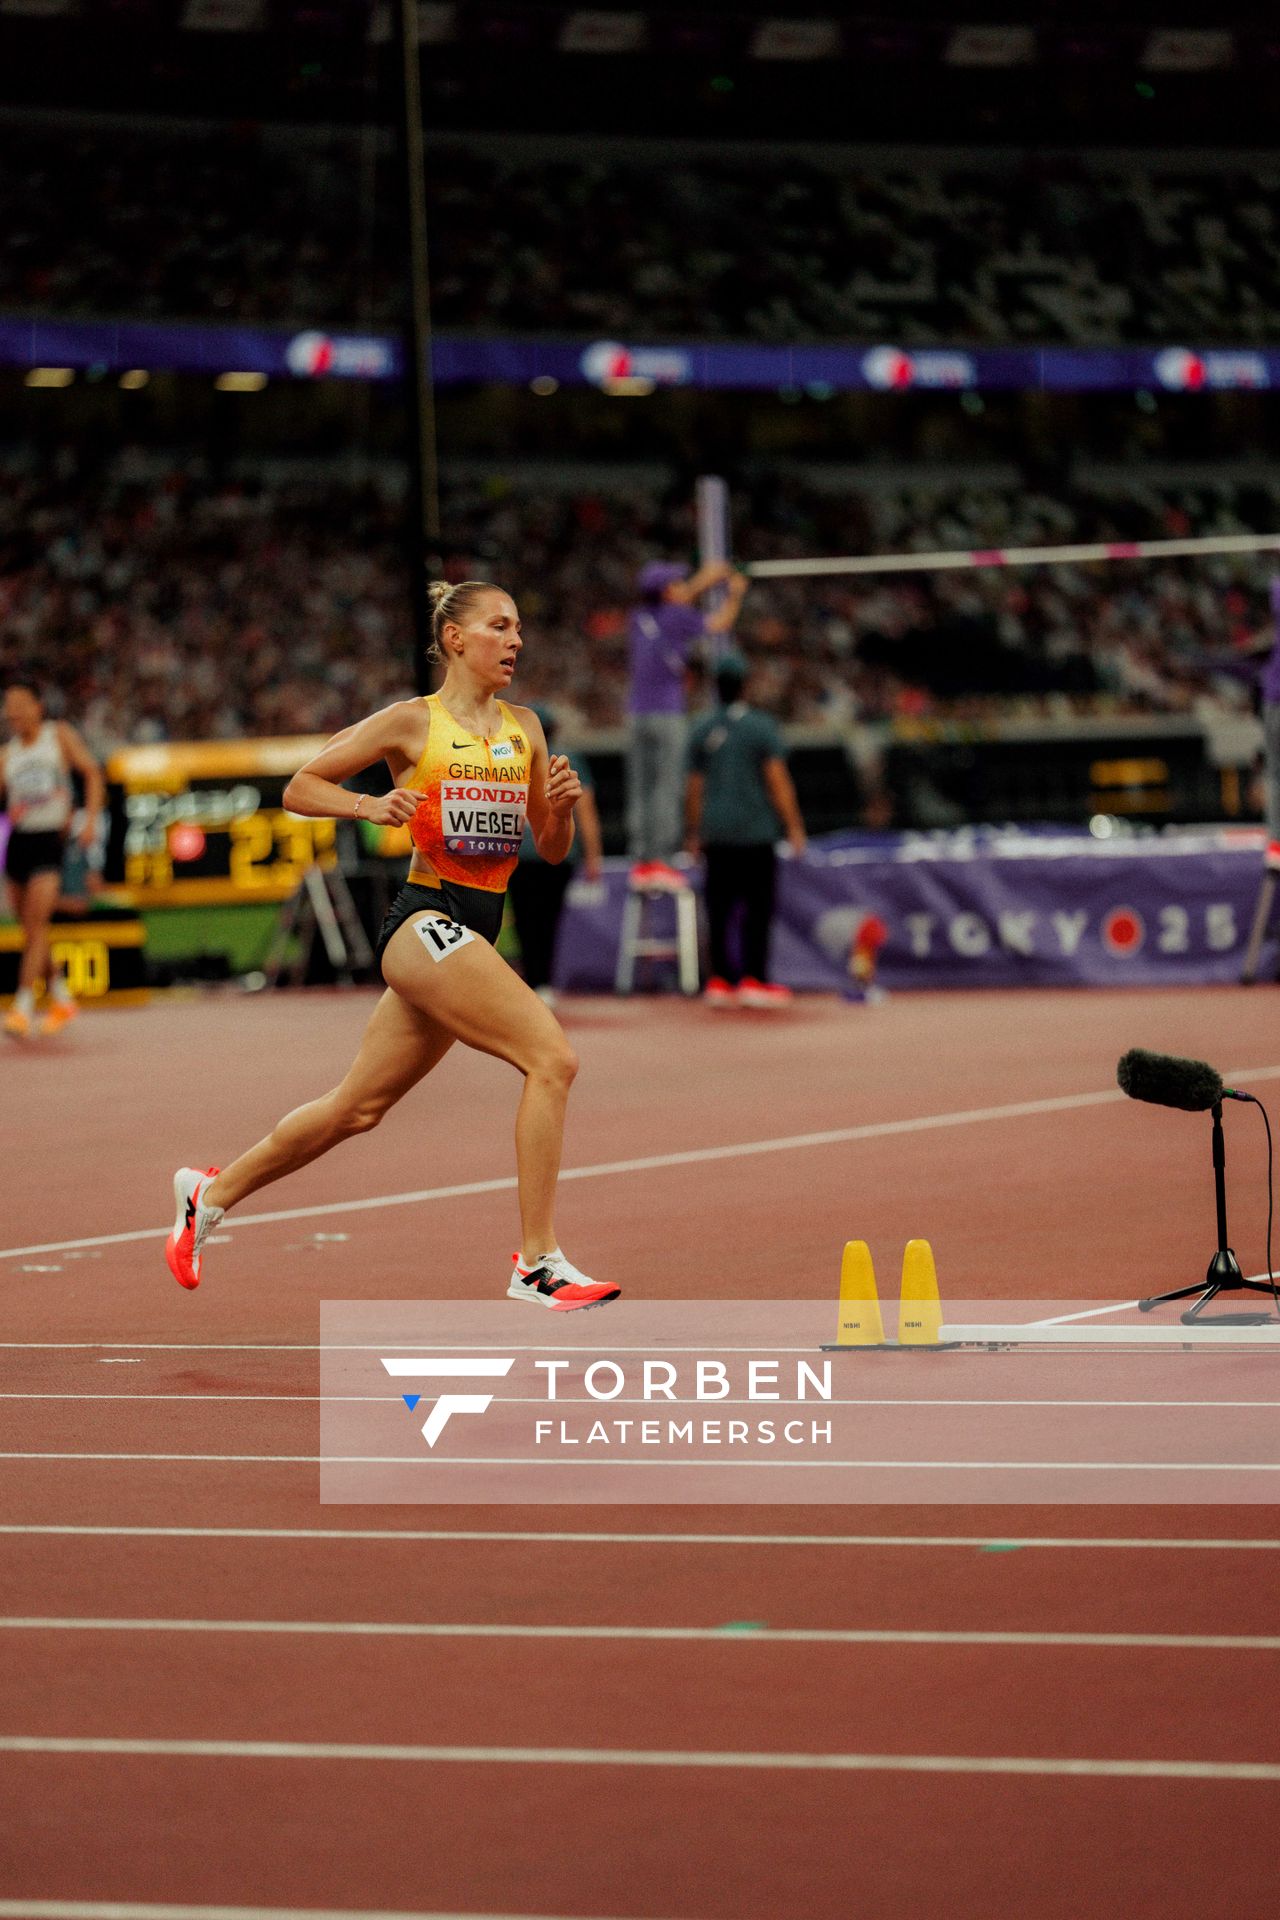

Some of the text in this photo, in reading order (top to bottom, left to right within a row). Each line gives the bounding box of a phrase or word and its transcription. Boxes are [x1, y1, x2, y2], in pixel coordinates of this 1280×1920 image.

[449, 763, 526, 782] GERMANY
[443, 787, 527, 804] HONDA
[448, 810, 522, 836] WEßEL
[420, 918, 463, 952] 13
[1157, 903, 1239, 952] 25
